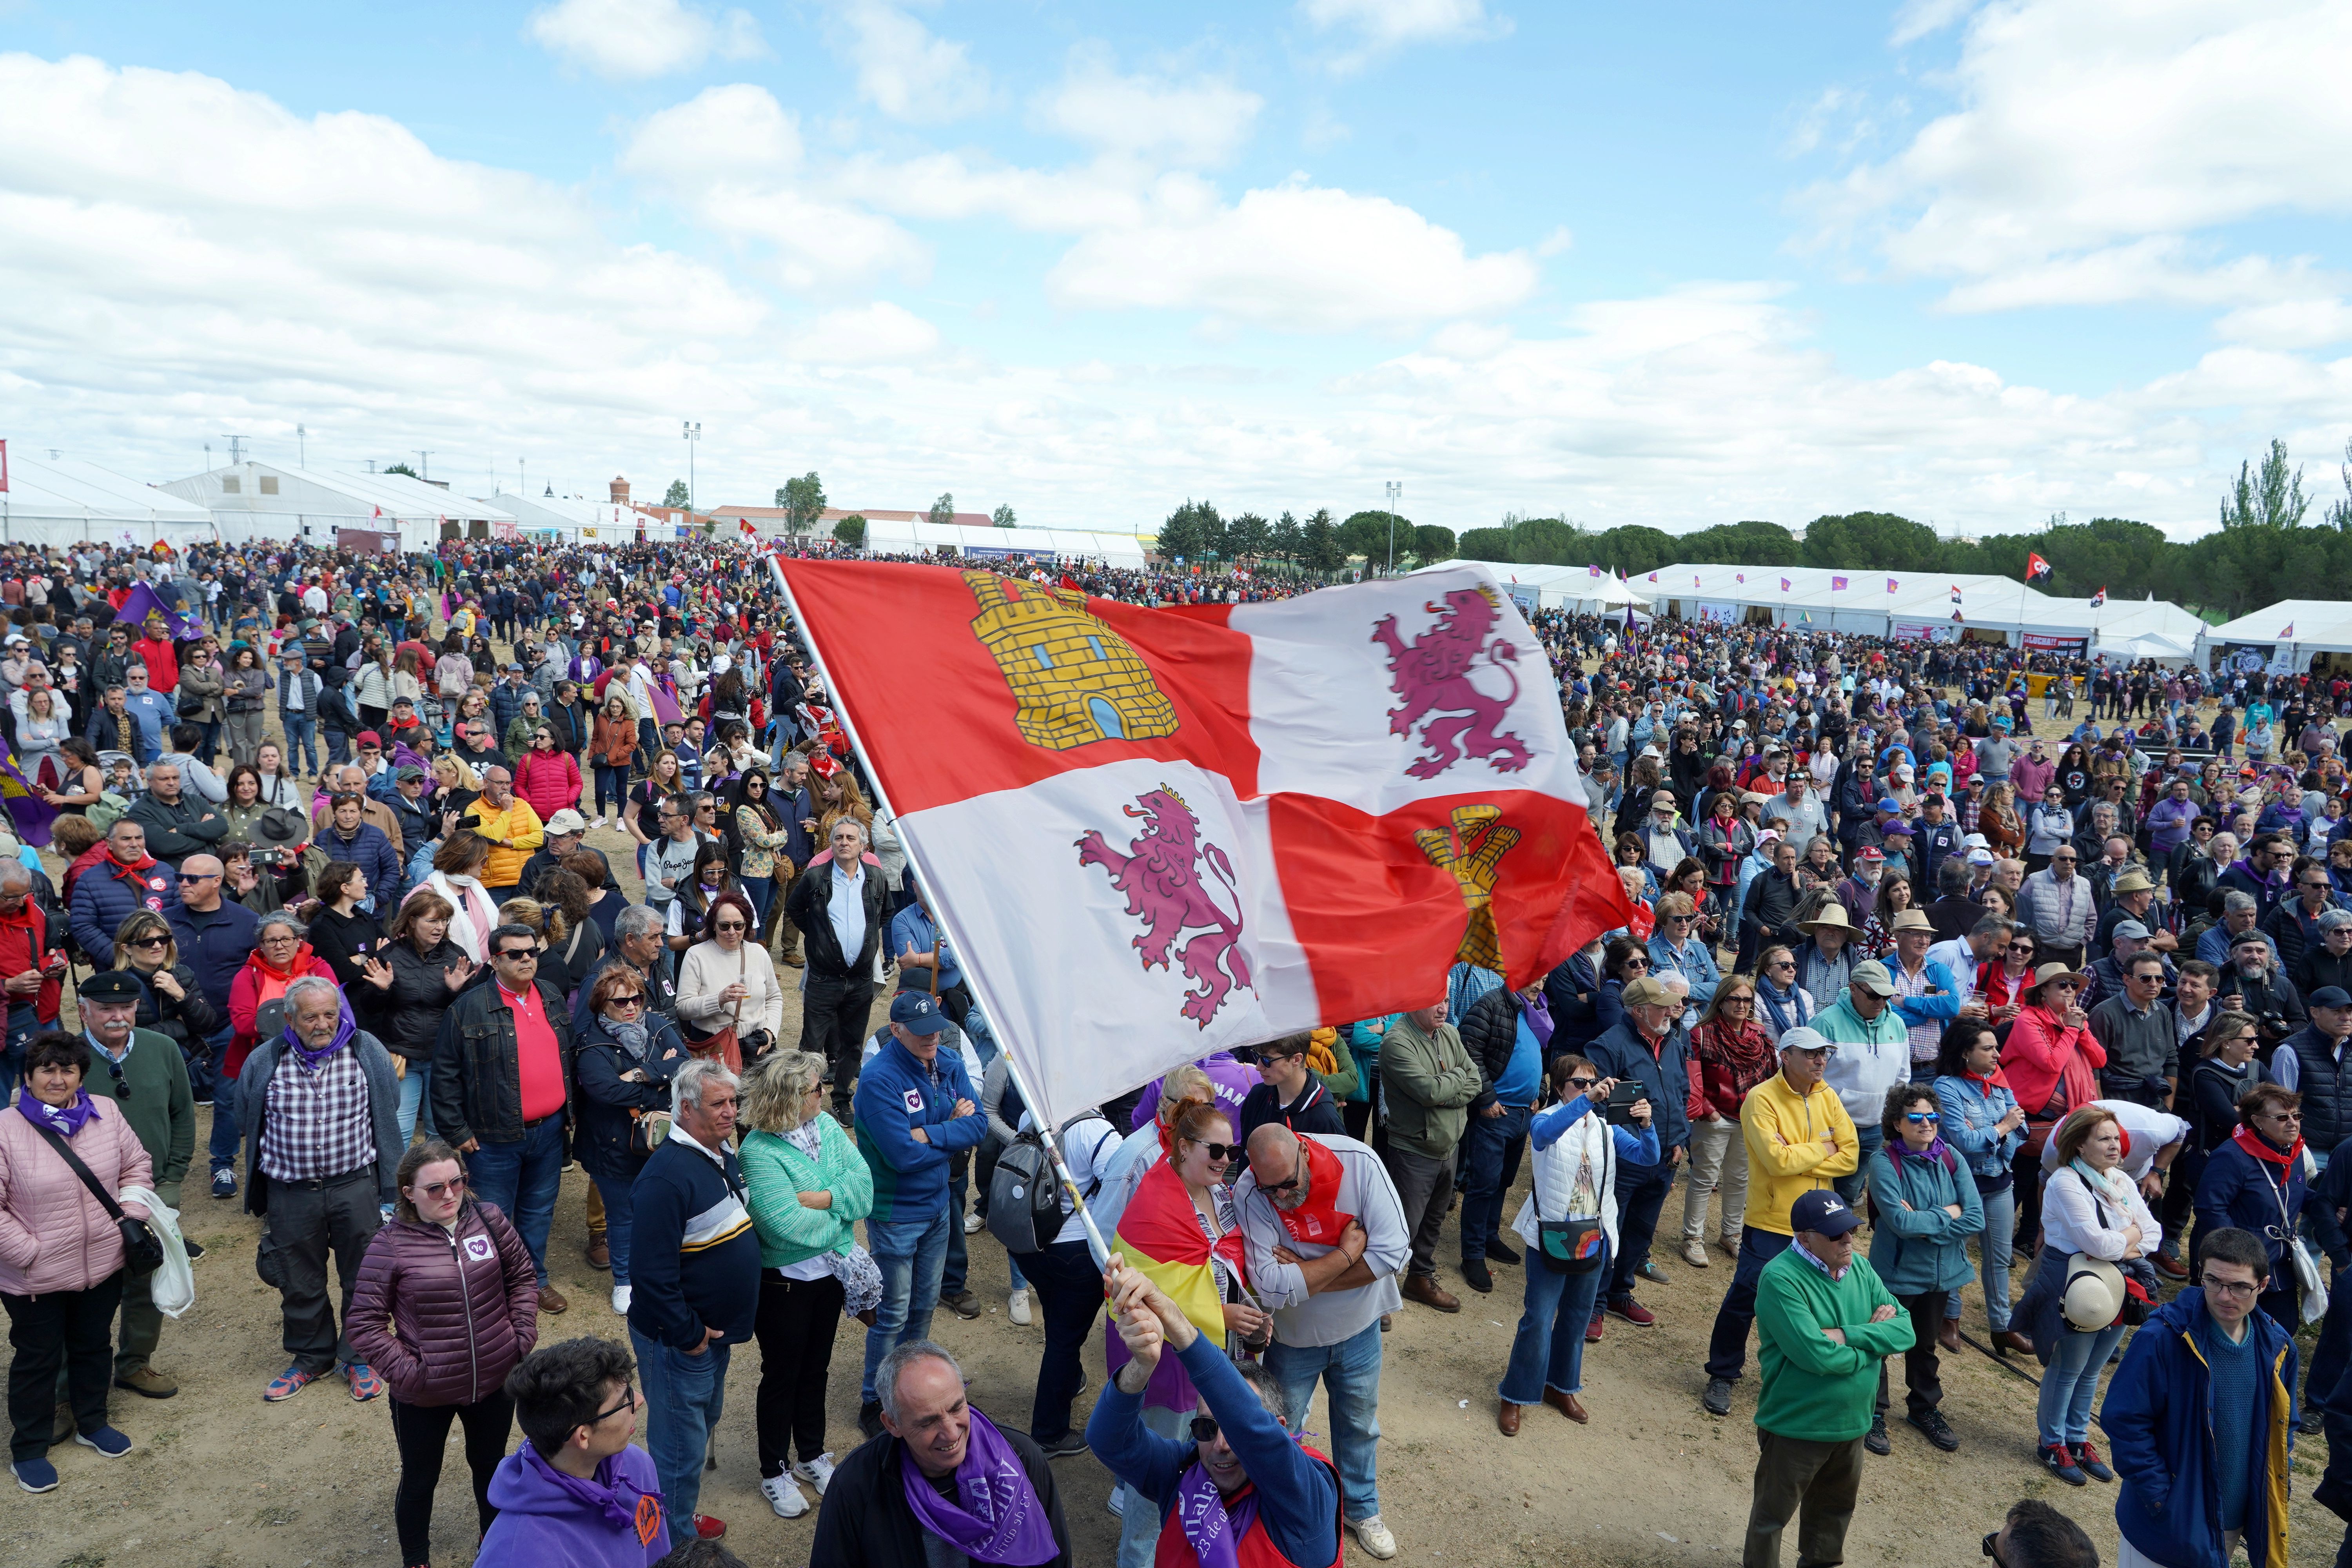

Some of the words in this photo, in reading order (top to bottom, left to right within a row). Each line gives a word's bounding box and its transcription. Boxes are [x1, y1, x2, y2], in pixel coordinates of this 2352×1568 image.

[664, 860, 682, 871] Pepe
[471, 1244, 483, 1252] Yo
[1198, 1539, 1210, 1559] 23
[1207, 1521, 1221, 1539] de
